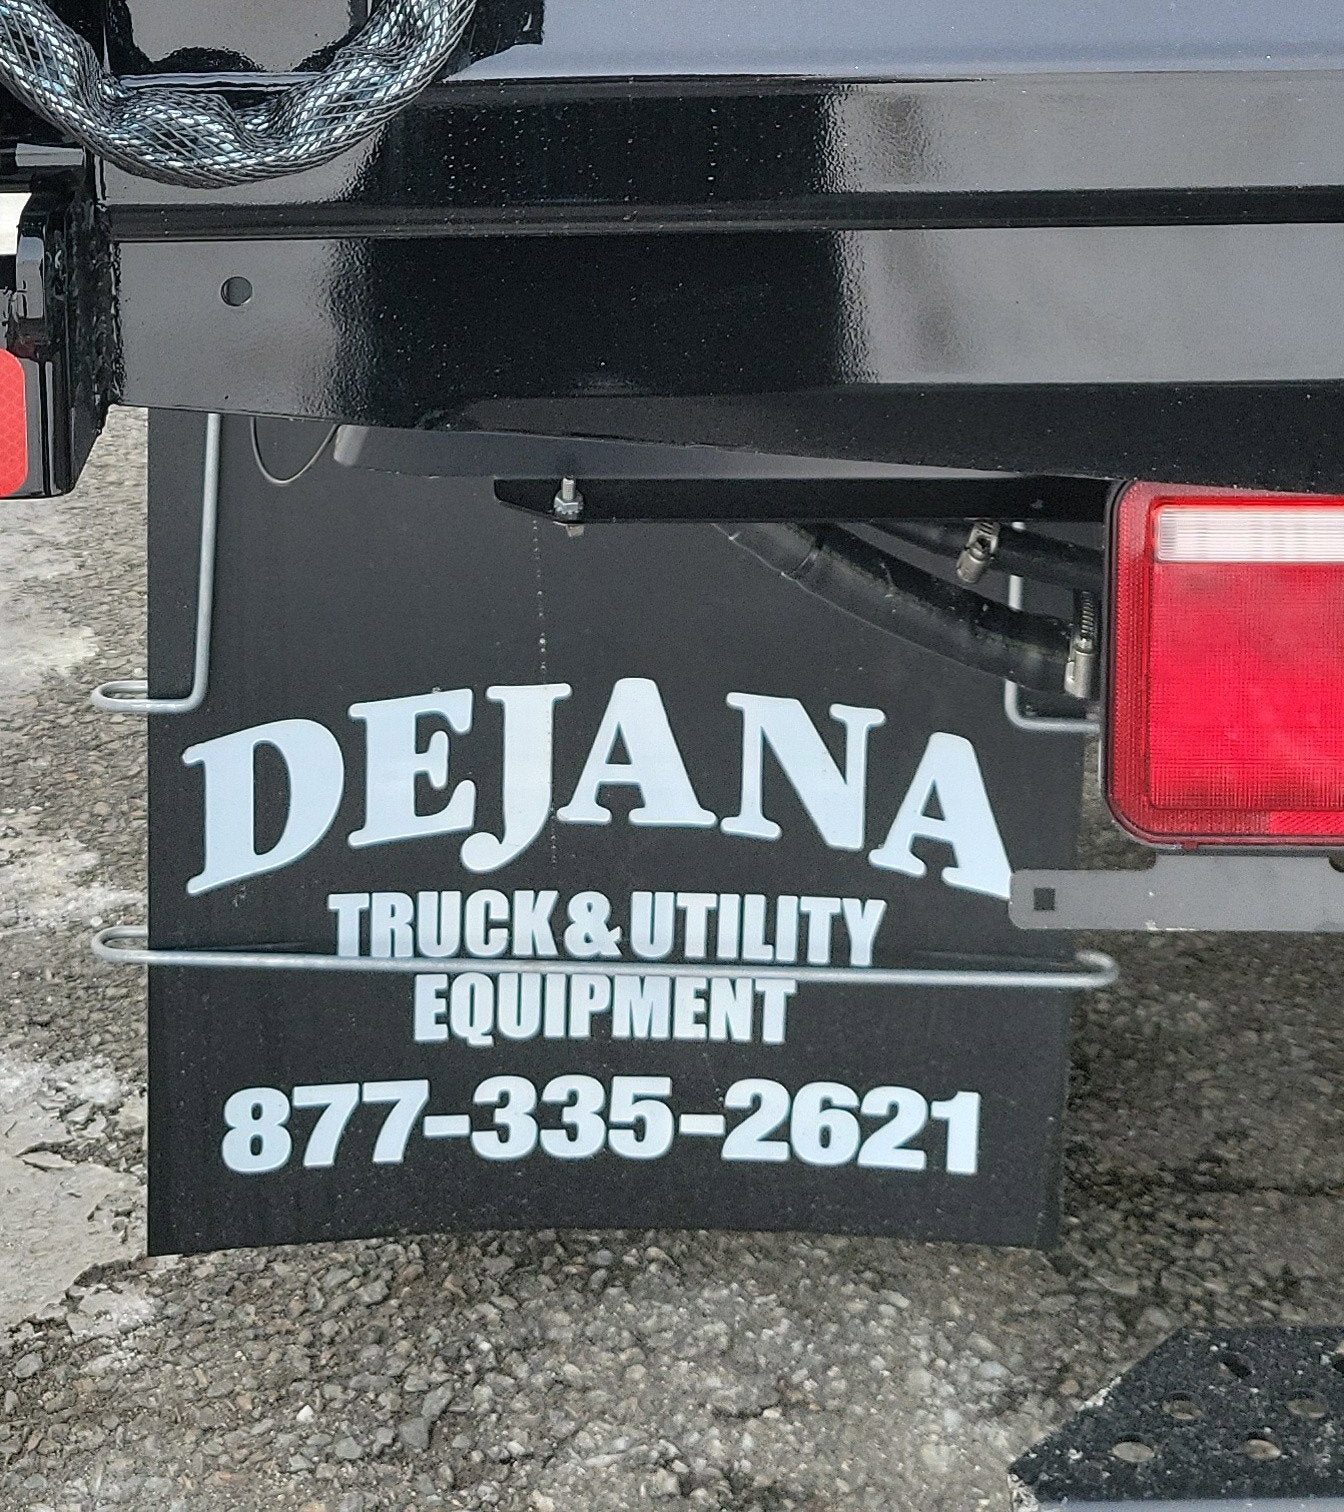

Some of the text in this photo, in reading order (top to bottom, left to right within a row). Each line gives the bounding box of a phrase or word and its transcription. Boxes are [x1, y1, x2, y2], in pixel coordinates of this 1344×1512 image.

[181, 677, 1014, 900] DEJANA
[413, 972, 798, 1048] EQUIPMENT
[222, 1074, 981, 1175] 877-335-2621
